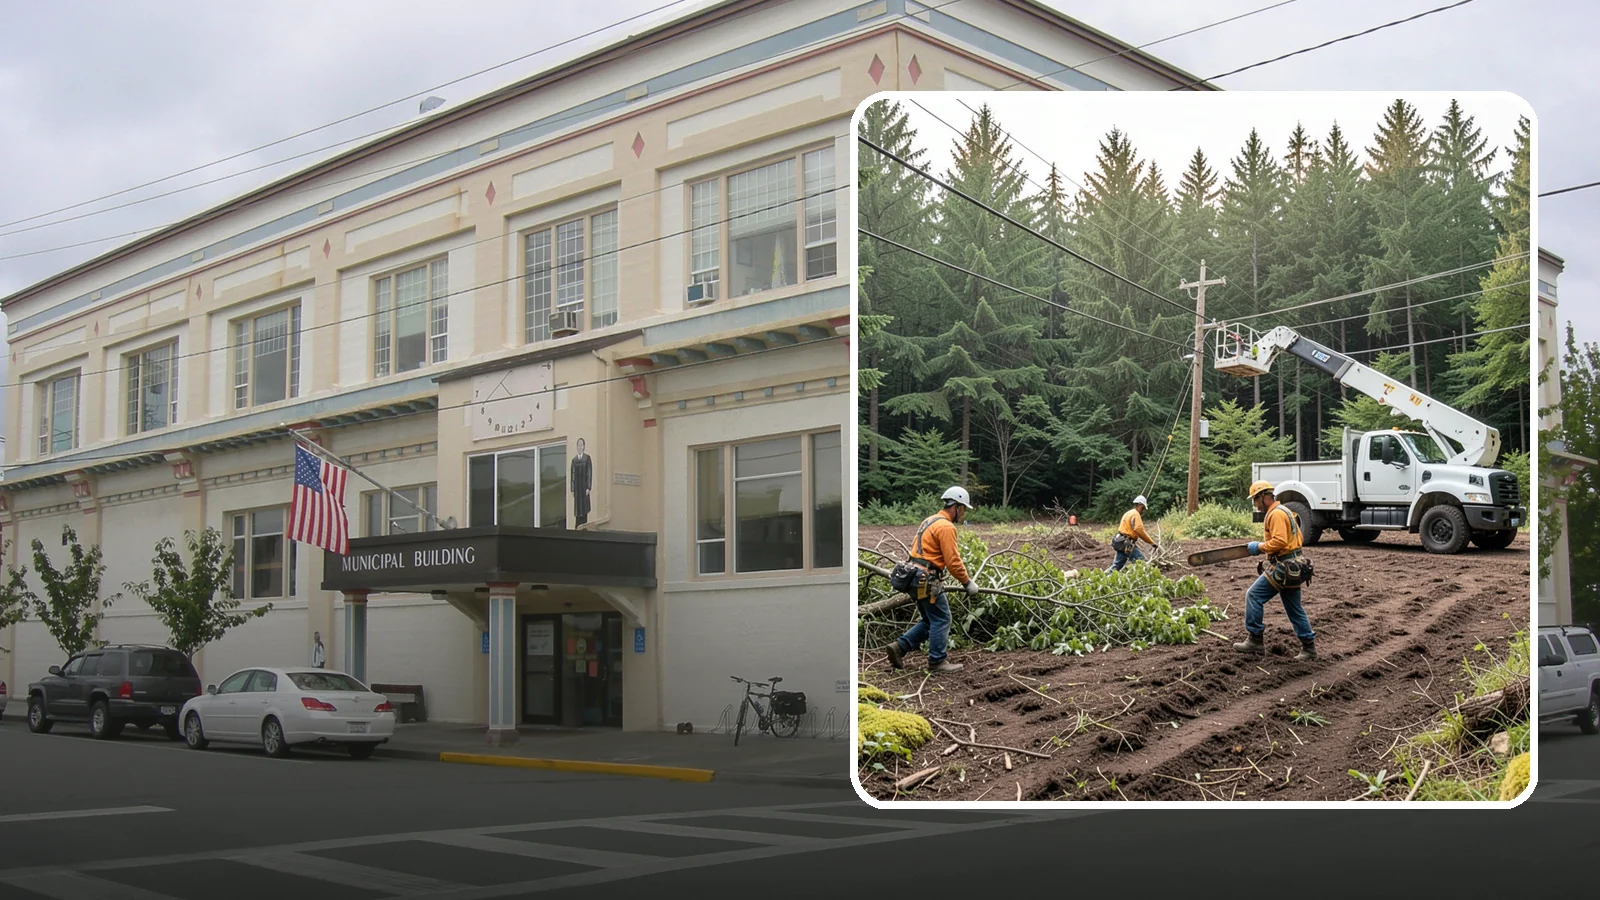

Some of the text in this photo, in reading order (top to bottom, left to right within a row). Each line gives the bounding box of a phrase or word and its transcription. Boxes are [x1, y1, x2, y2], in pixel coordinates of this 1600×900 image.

[546, 361, 552, 370] 6
[475, 390, 479, 398] 7
[480, 406, 485, 415] 8
[536, 402, 540, 410] 4
[487, 417, 492, 426] 9
[529, 413, 533, 422] 3
[494, 423, 500, 432] 10
[521, 420, 526, 428] 2
[501, 425, 506, 434] 11
[507, 425, 513, 433] 12
[342, 546, 475, 572] MUNICIPAL BUILDING
